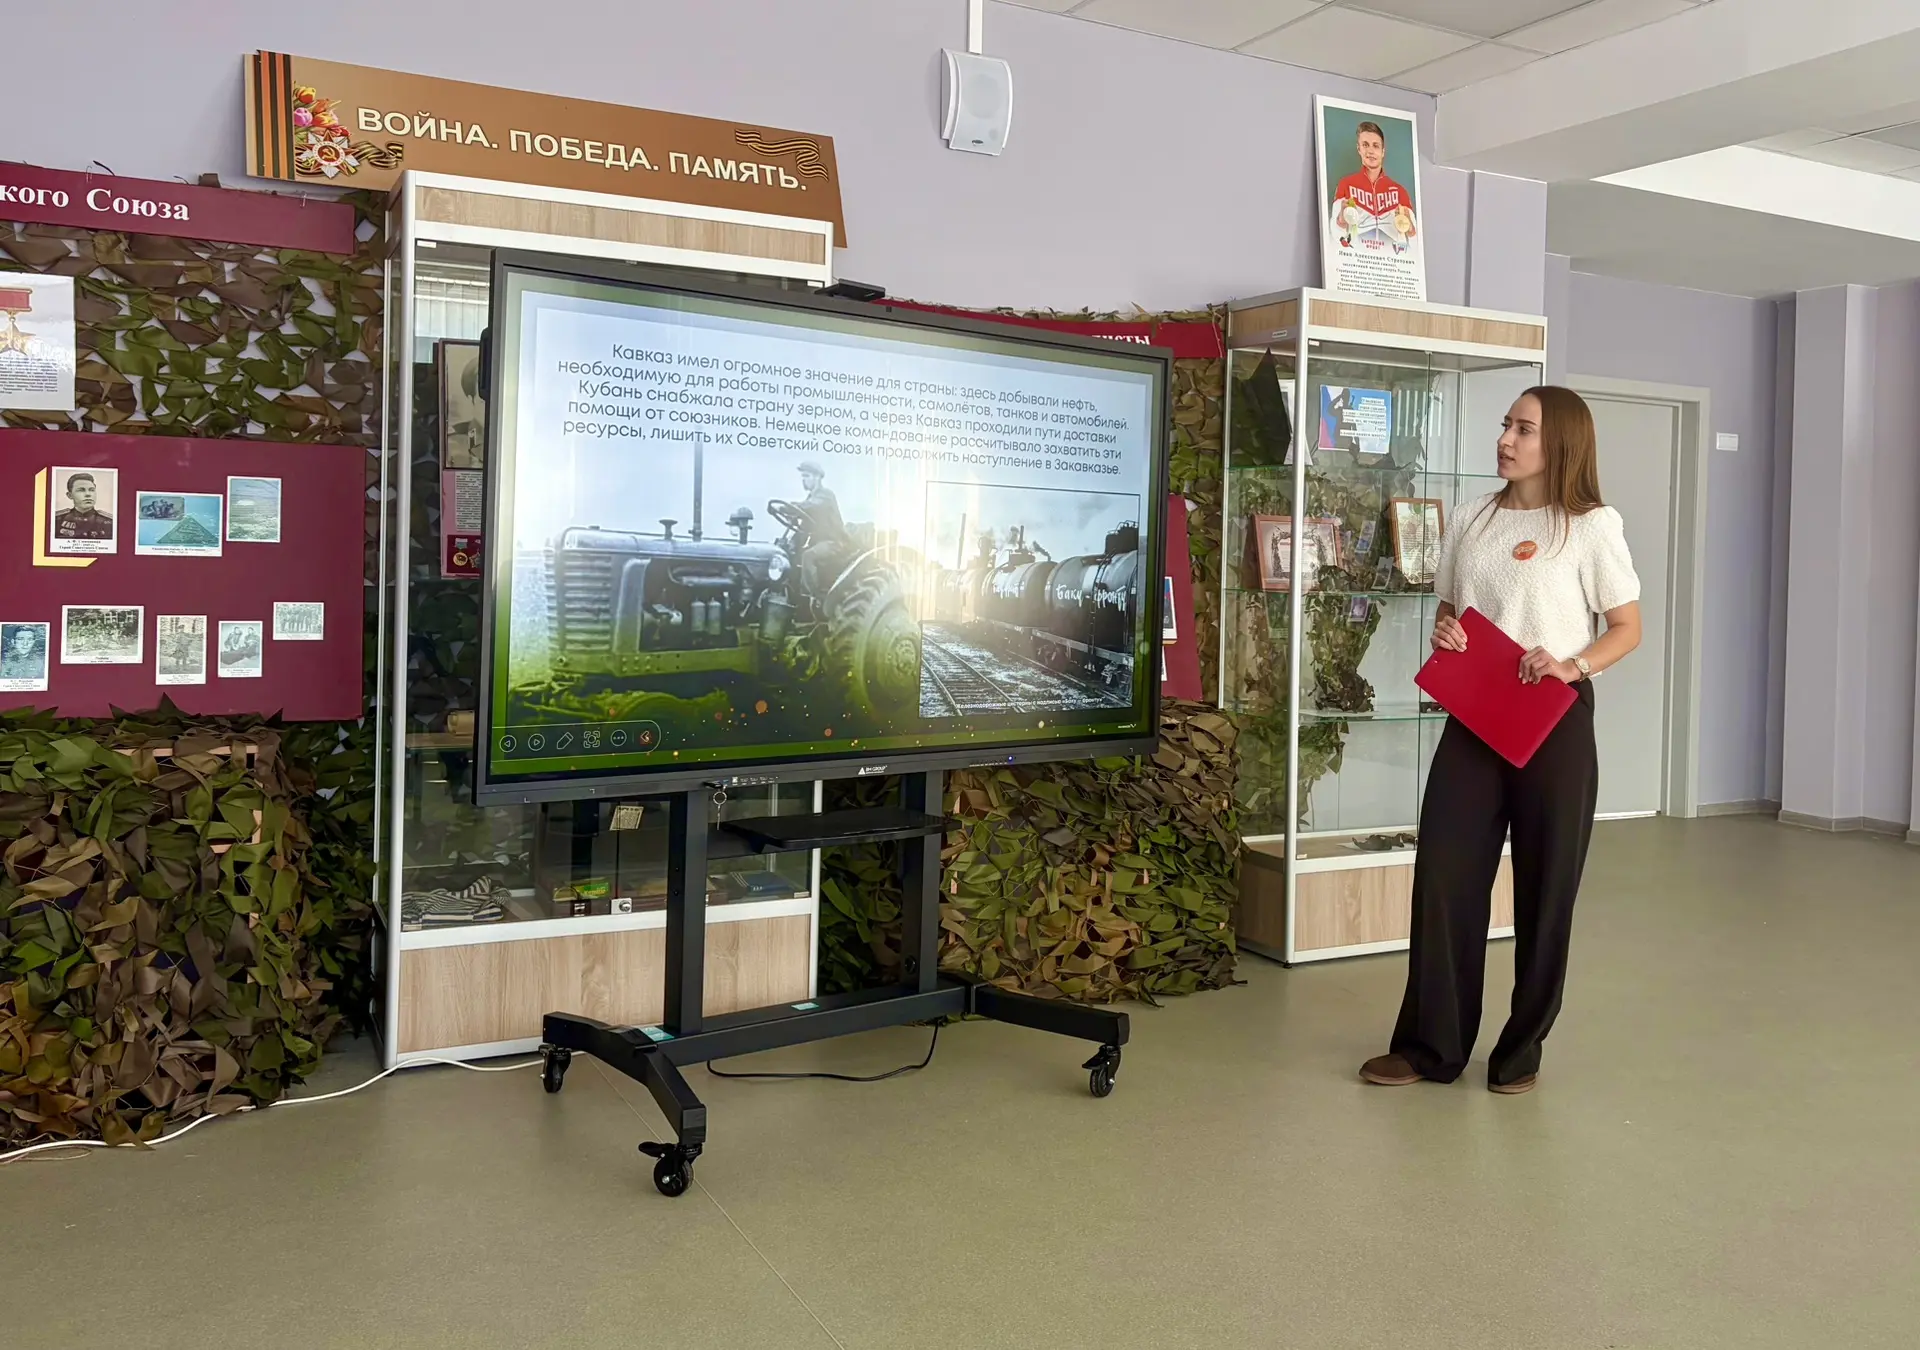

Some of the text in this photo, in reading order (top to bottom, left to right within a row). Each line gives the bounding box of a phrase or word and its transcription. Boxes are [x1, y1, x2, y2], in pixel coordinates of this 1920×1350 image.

[357, 107, 807, 191] ВОЙНА. ПОБЕДА. ПАМЯТЬ.
[86, 188, 190, 221] Союза
[558, 360, 1130, 430] необходимую для работы промышленности, самолётов, танков и автомобилей.
[612, 344, 1098, 412] Кавказ имел огромное значение для страны: здесь добывали нефть,
[568, 401, 1122, 460] помощи от союзников. Немецкое командование рассчитывало захватить эти
[579, 380, 1116, 444] Кубань снабжала страну зерном, а через Кавказ проходили пути доставки
[563, 419, 1121, 475] ресурсы, лишить их Советский Союз и продолжить наступление в Закавказье.
